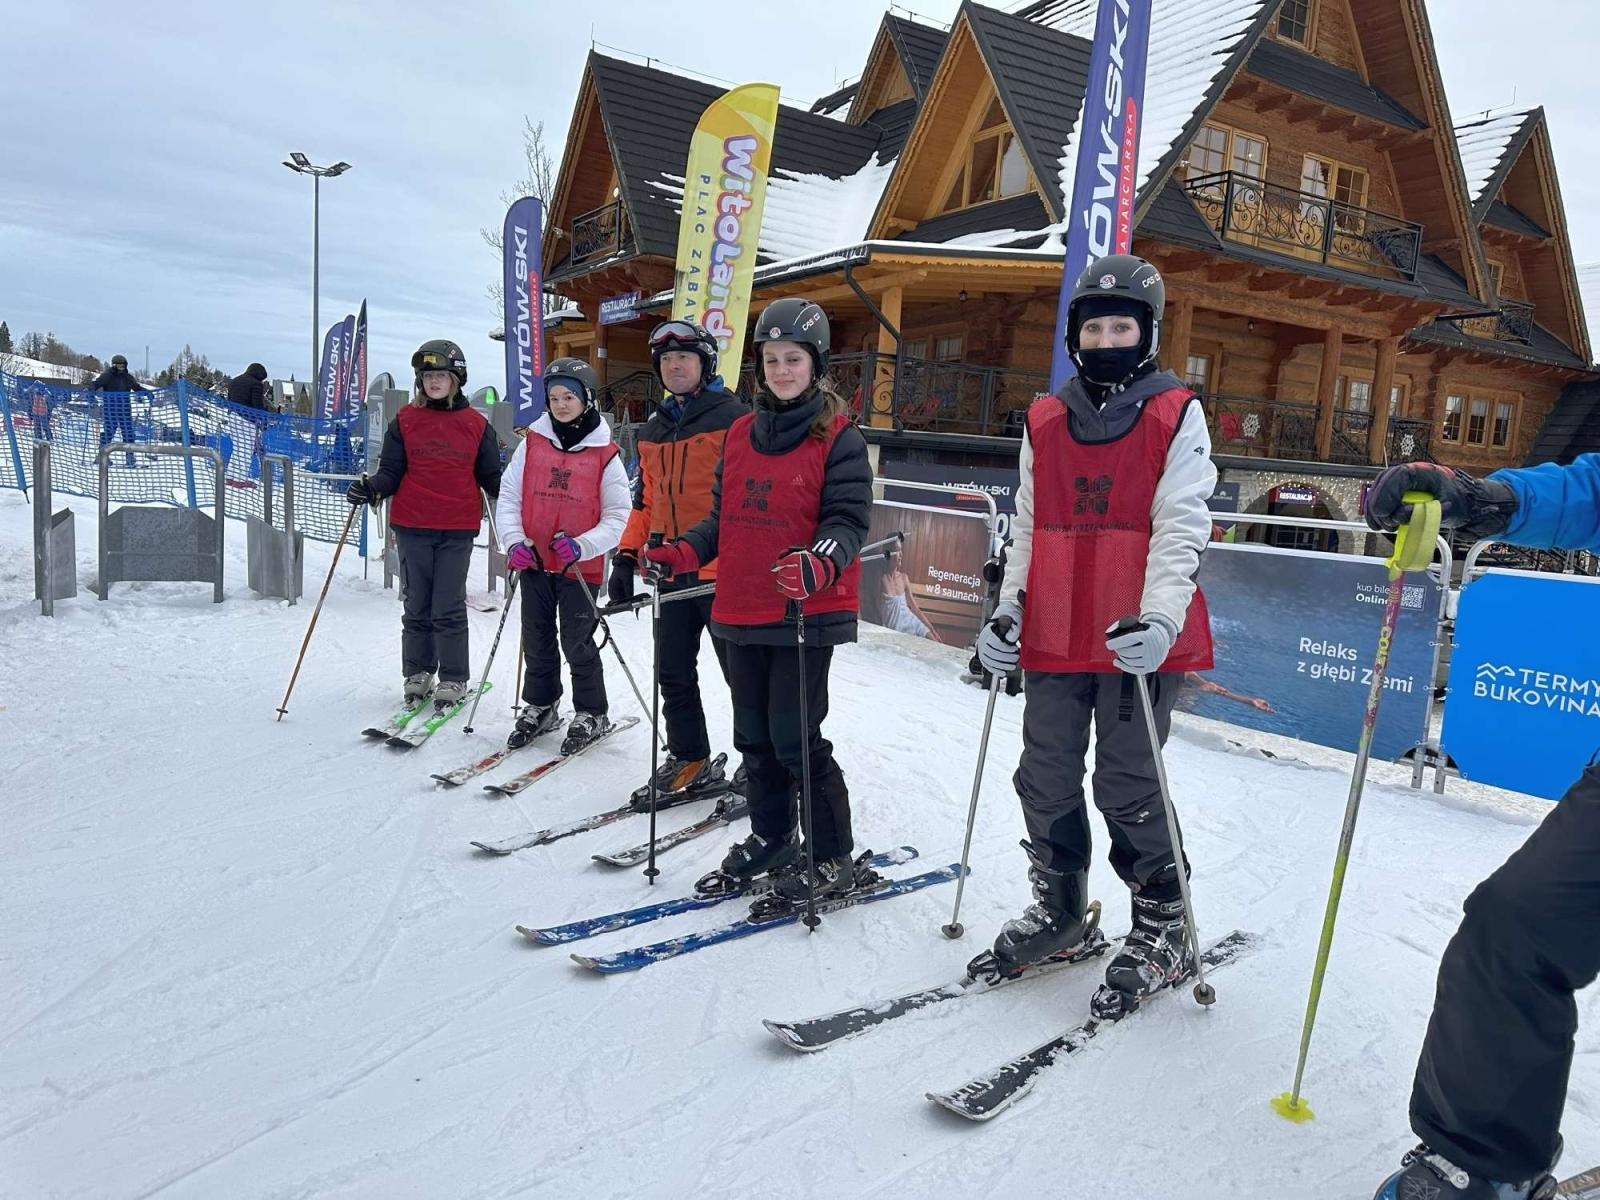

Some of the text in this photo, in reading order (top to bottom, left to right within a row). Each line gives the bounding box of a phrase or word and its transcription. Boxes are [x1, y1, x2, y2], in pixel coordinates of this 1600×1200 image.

[1083, 0, 1130, 266] ÓW-SKI
[1120, 113, 1134, 234] NARCIARSKA
[695, 174, 711, 234] PLAC
[513, 225, 533, 411] WITÓW-SKI
[601, 296, 637, 313] RESTAURACJ
[927, 565, 981, 588] Regeneracja
[1374, 584, 1390, 595] bile
[942, 587, 979, 603] saunach
[1355, 593, 1388, 605] Onlin
[1299, 636, 1358, 661] Relaks
[1296, 661, 1414, 693] z głębi Zemi
[1518, 668, 1600, 697] TERMY
[1473, 680, 1600, 717] BUKOVINA
